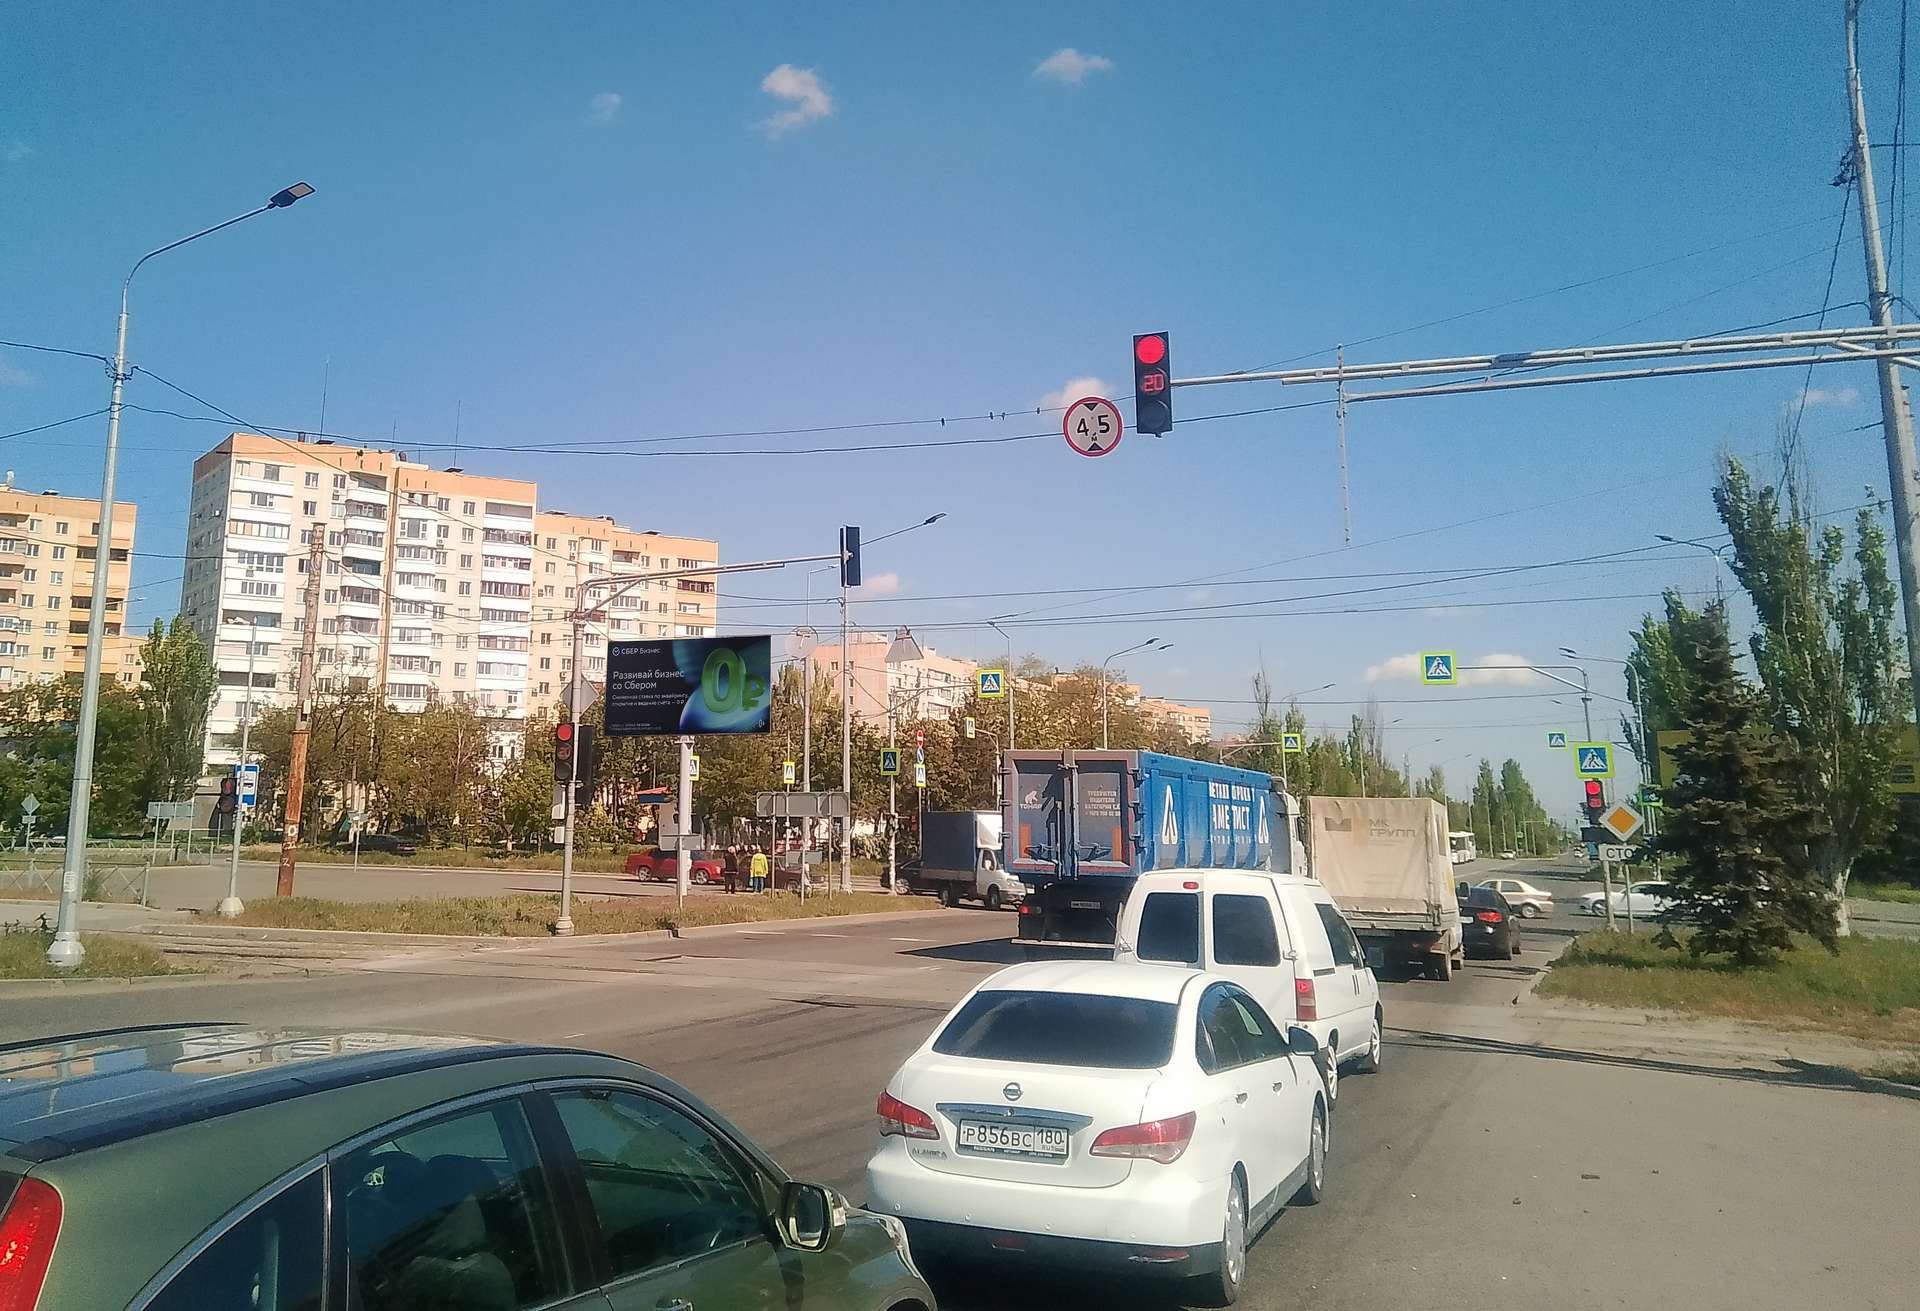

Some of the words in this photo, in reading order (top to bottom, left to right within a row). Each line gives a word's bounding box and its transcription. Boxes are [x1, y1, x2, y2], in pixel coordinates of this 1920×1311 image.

[1142, 374, 1164, 392] 20
[621, 647, 639, 655] СБЕР
[640, 647, 662, 655] Бизнес
[613, 668, 653, 680] Развивай
[654, 668, 686, 679] бизнес
[612, 682, 622, 690] со
[624, 680, 657, 691] Сбером
[1370, 828, 1416, 837] ГРУПП
[1037, 1129, 1064, 1145] 180
